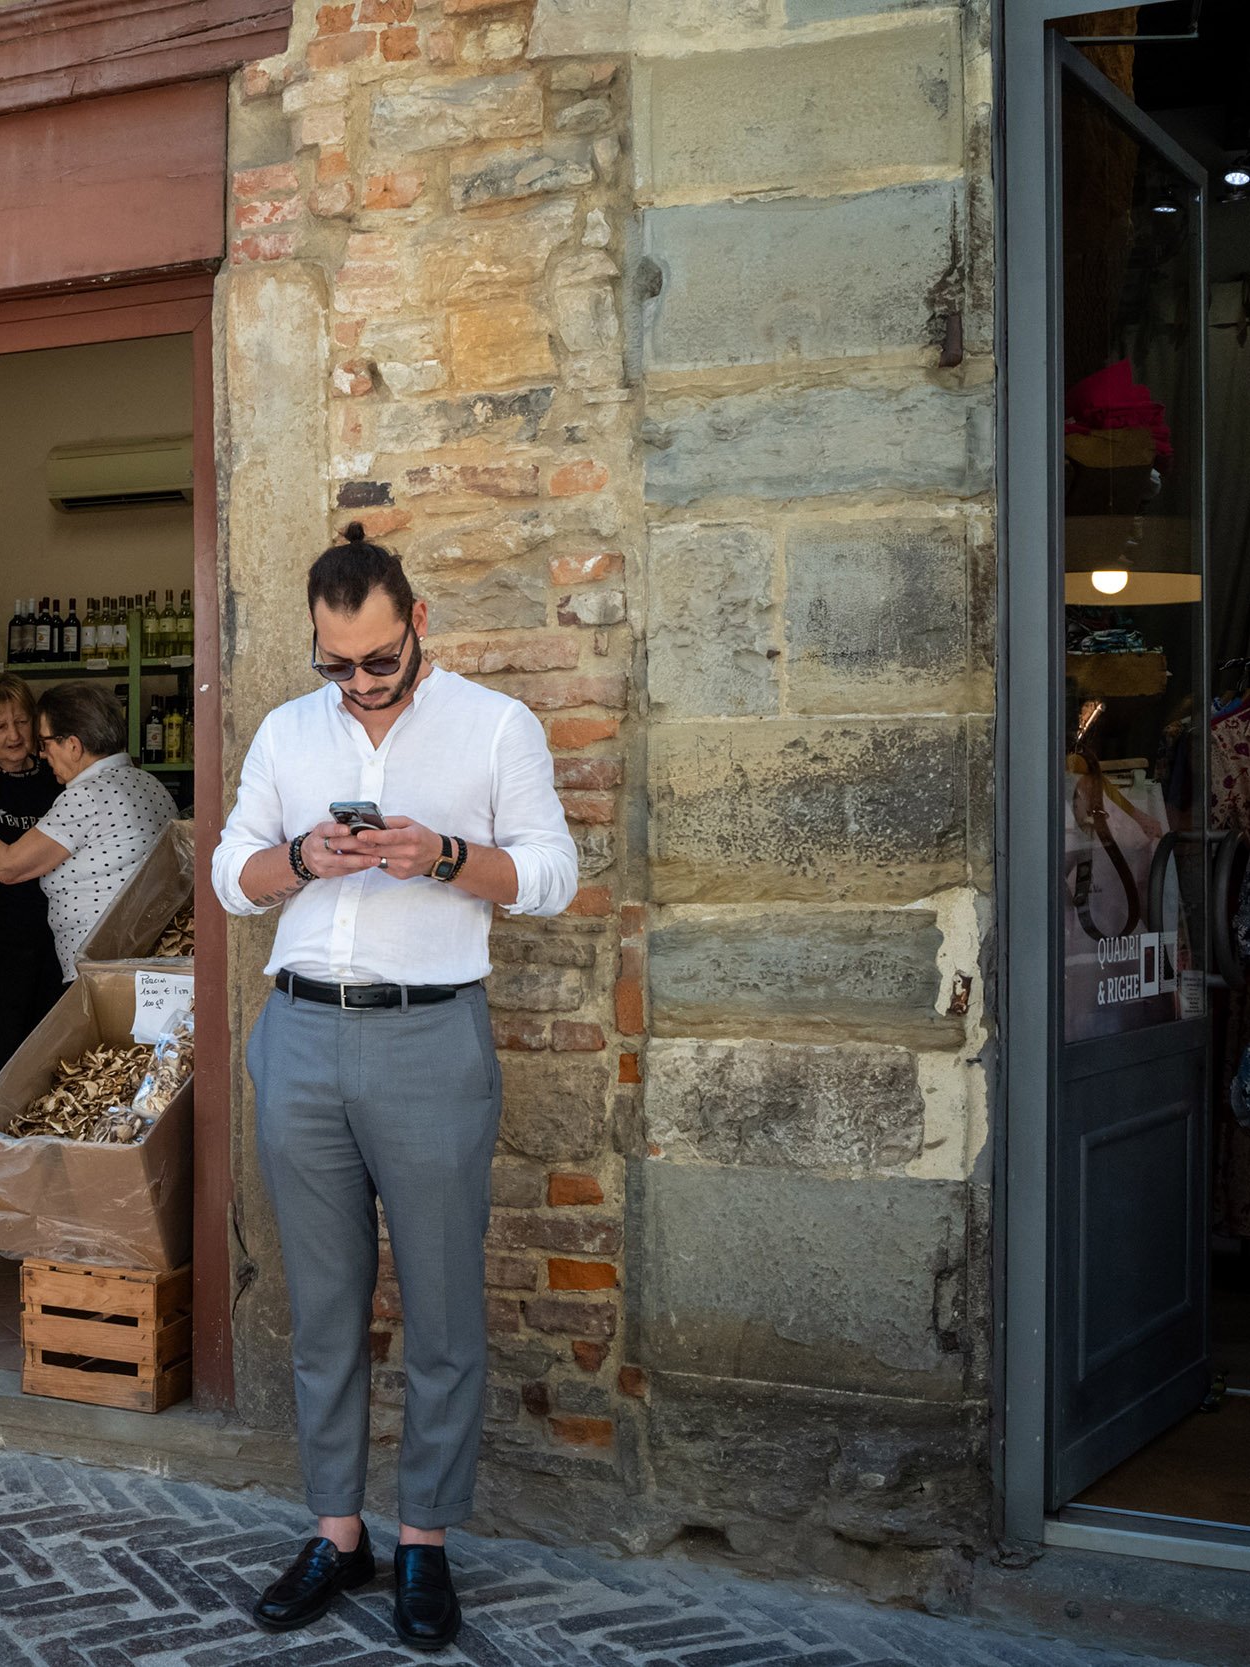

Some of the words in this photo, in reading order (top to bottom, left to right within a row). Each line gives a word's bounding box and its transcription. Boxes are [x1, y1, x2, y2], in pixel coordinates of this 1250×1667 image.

[1098, 936, 1139, 969] QUADRI
[1098, 981, 1105, 1005] &
[1107, 974, 1139, 1003] RIGHE
